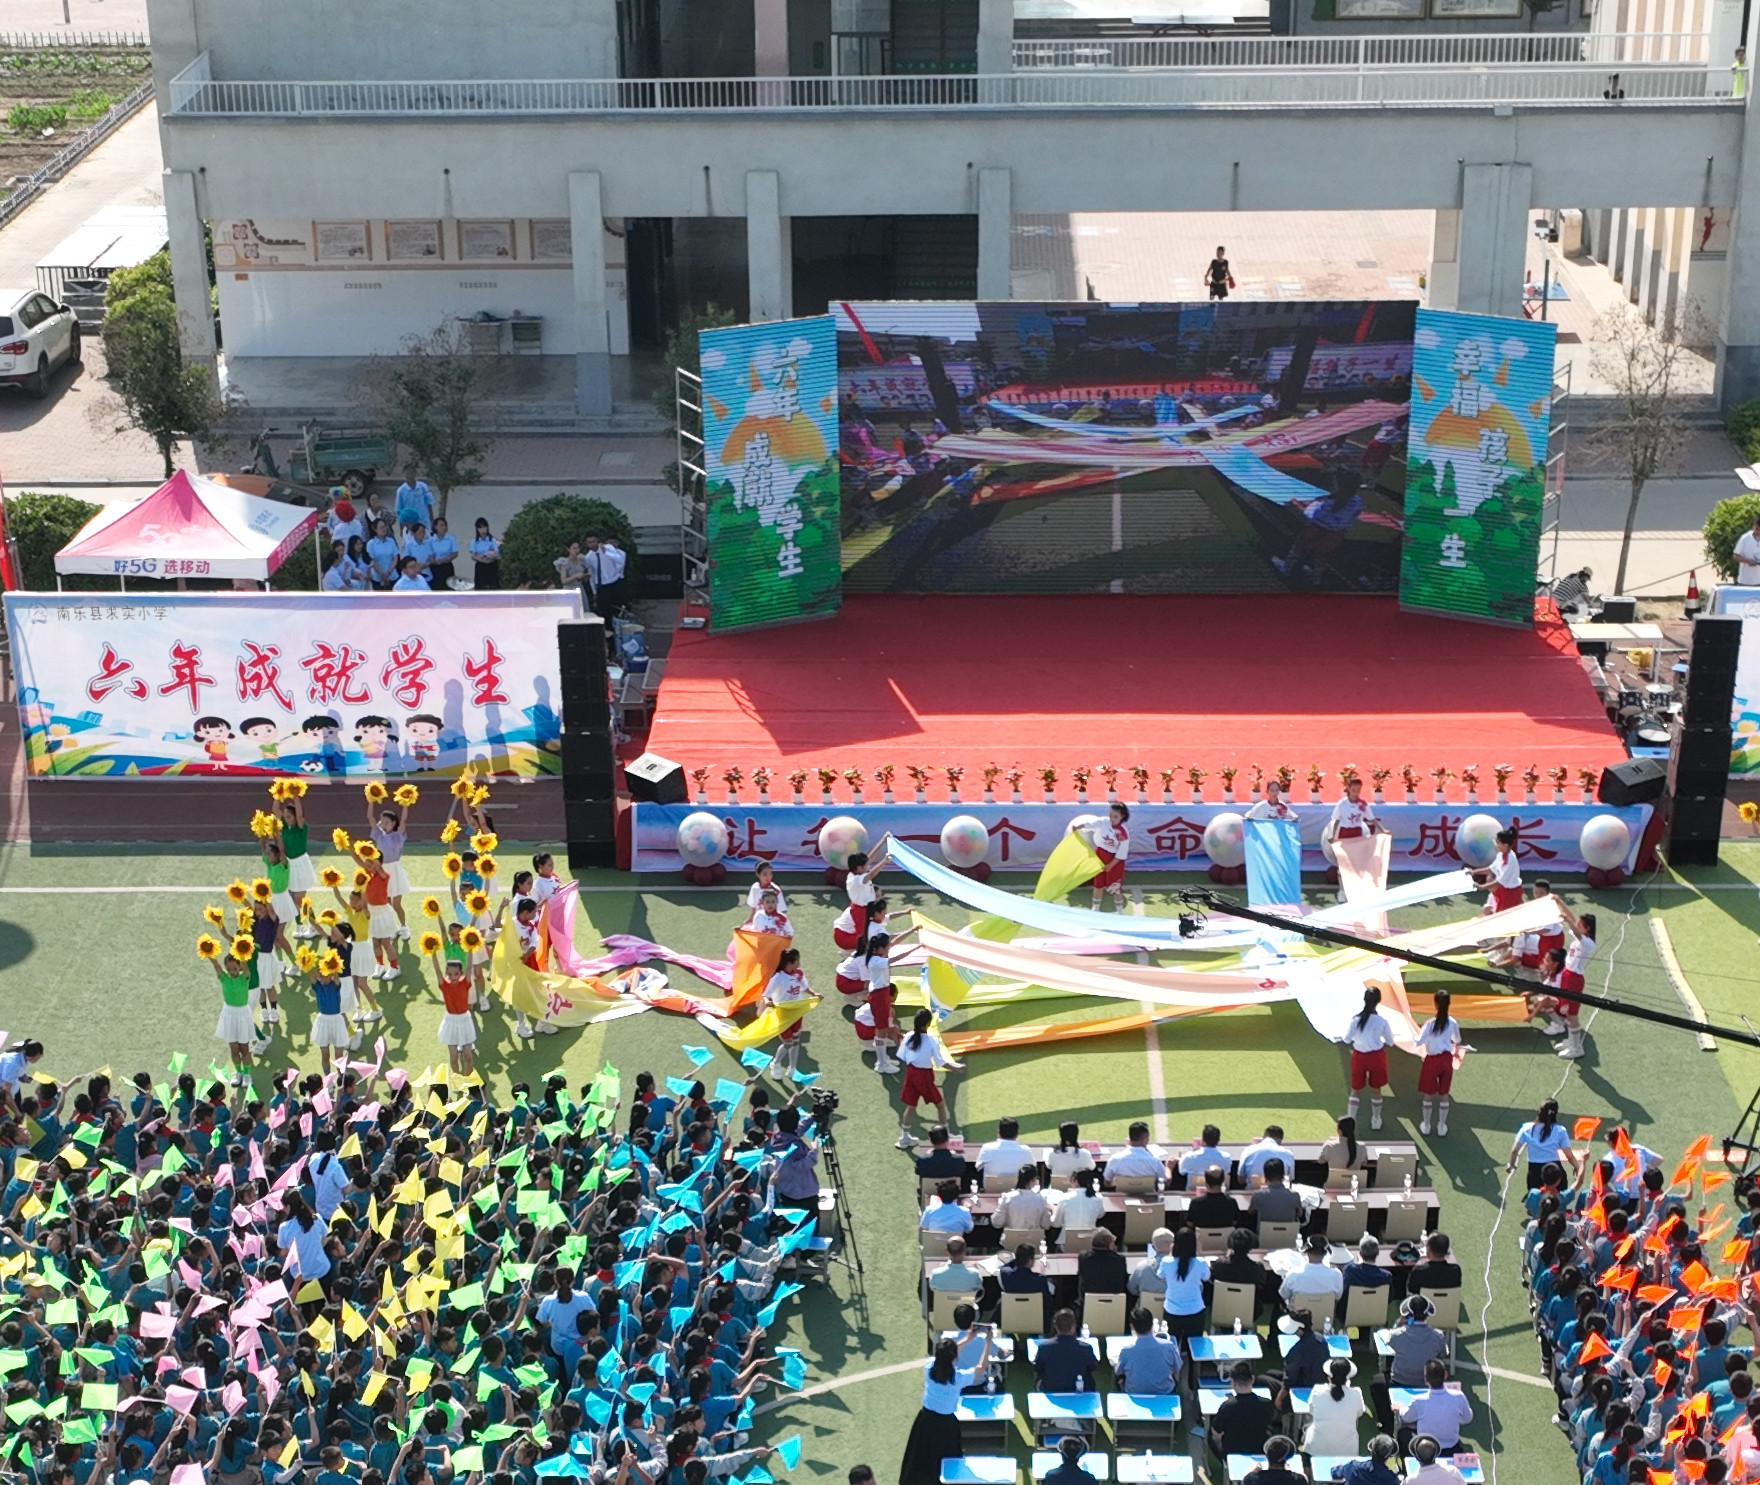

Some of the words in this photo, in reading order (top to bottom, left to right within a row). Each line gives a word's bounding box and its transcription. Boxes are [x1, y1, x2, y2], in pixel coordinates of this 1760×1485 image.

[113, 557, 158, 575] 好5G
[163, 559, 211, 575] 选移动
[88, 636, 511, 713] 六年成就学生
